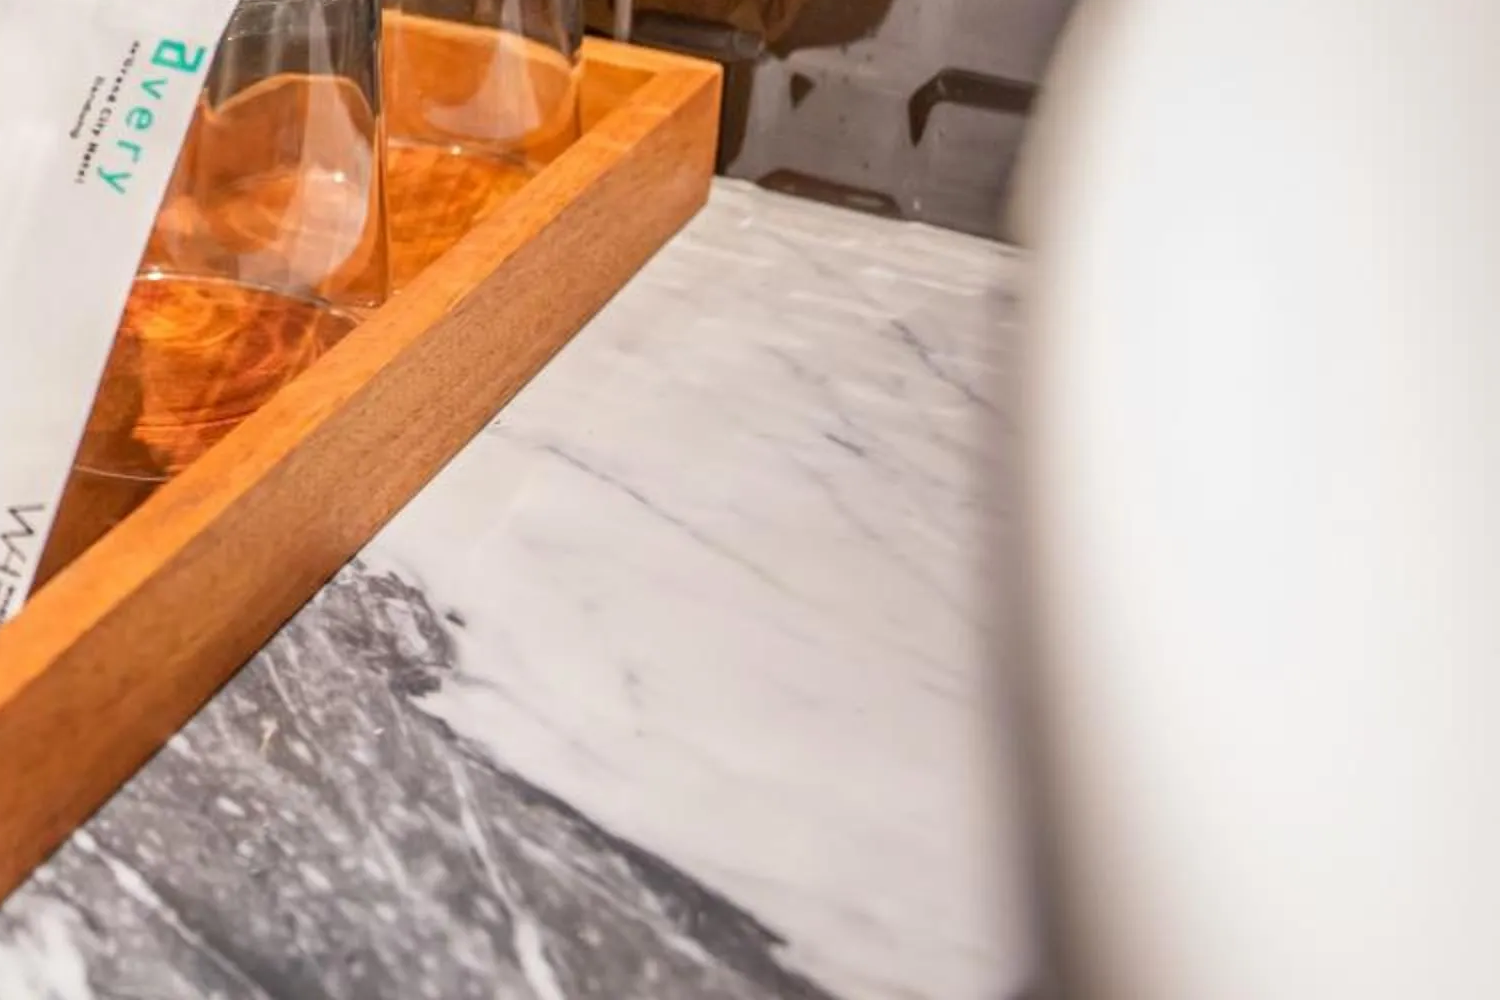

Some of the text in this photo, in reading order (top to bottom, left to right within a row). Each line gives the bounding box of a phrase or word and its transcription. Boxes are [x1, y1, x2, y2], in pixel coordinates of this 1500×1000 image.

[91, 105, 112, 137] City
[97, 38, 207, 195] avery
[73, 141, 99, 184] Hotel
